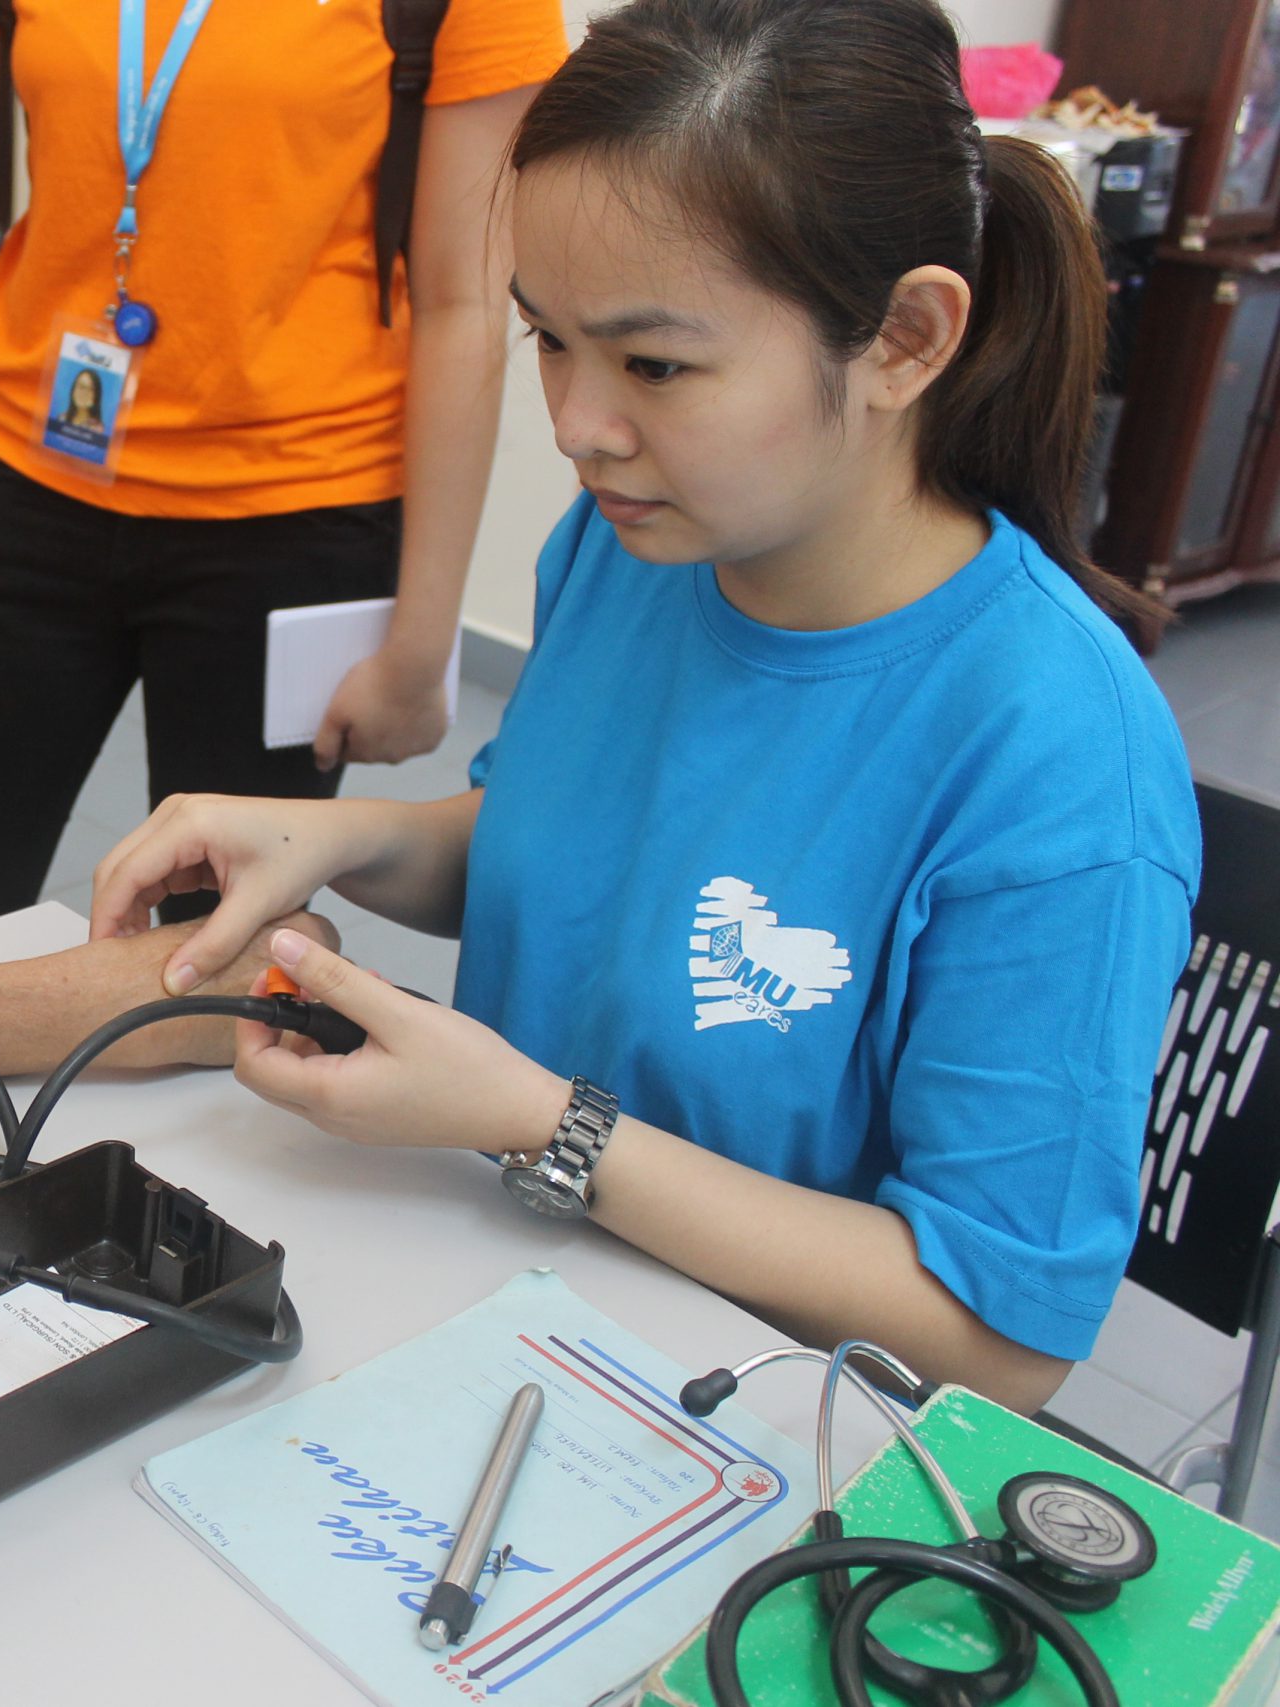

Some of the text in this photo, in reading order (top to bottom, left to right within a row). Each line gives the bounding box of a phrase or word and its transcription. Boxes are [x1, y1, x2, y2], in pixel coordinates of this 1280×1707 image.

[3, 1302, 18, 1316] LTD
[54, 1343, 70, 1355] SON
[554, 1433, 613, 1473] LITERATURE
[679, 1471, 696, 1484] 120
[301, 1442, 555, 1574] Ltihan
[433, 1664, 486, 1703] 2020
